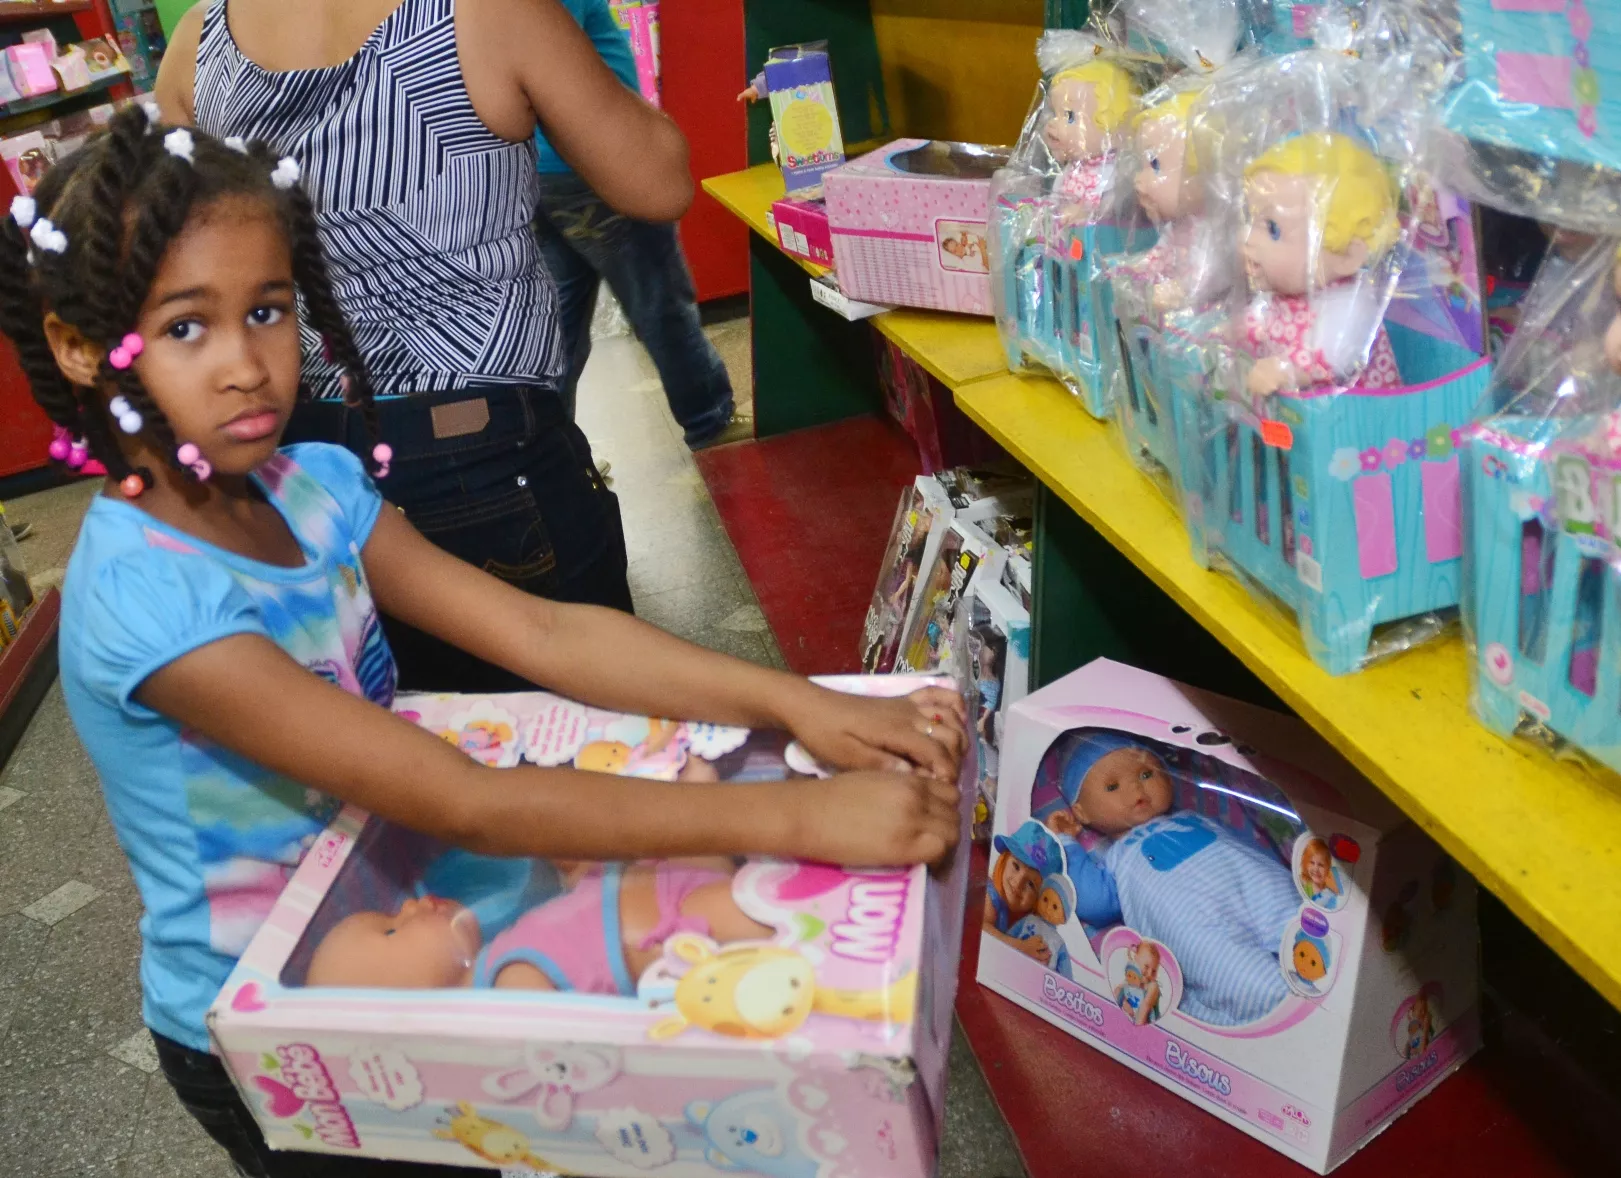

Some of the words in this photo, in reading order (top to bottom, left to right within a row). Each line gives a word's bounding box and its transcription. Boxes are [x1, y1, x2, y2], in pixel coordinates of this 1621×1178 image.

[828, 878, 911, 963] Mon
[1043, 974, 1105, 1027] Besitos
[1165, 1040, 1232, 1096] Bisous
[309, 1103, 362, 1149] Mon
